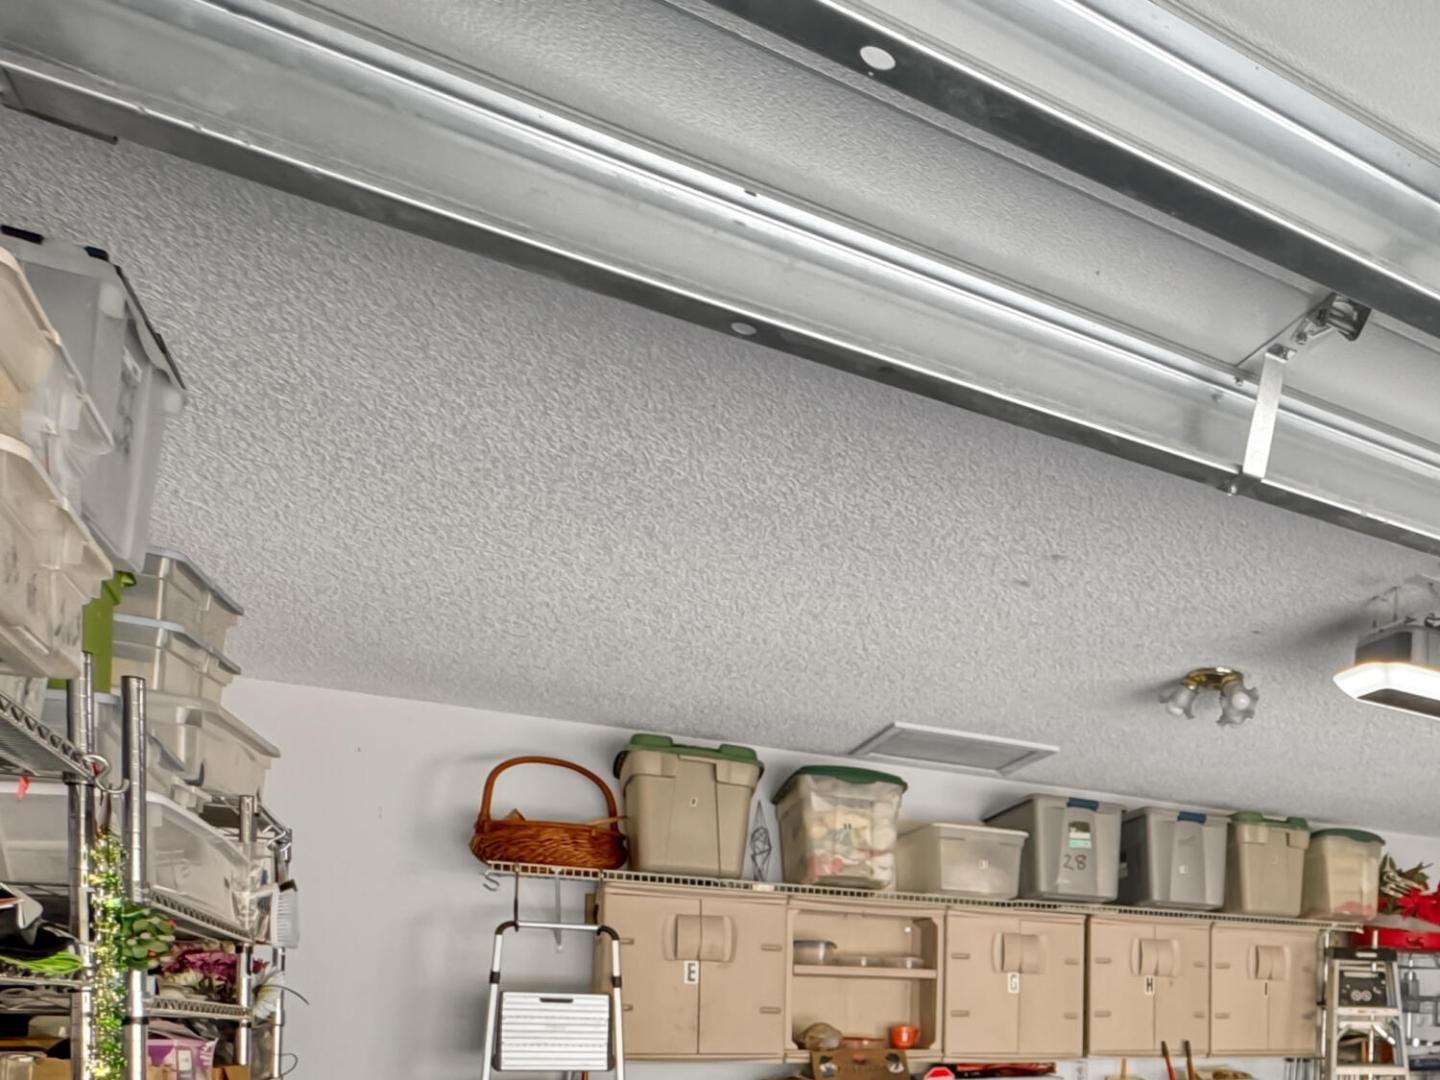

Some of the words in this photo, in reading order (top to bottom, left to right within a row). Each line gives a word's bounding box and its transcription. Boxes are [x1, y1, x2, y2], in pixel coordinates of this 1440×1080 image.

[1063, 853, 1087, 871] 28
[688, 963, 696, 981] E
[1010, 974, 1018, 991] G
[1146, 976, 1153, 992] H
